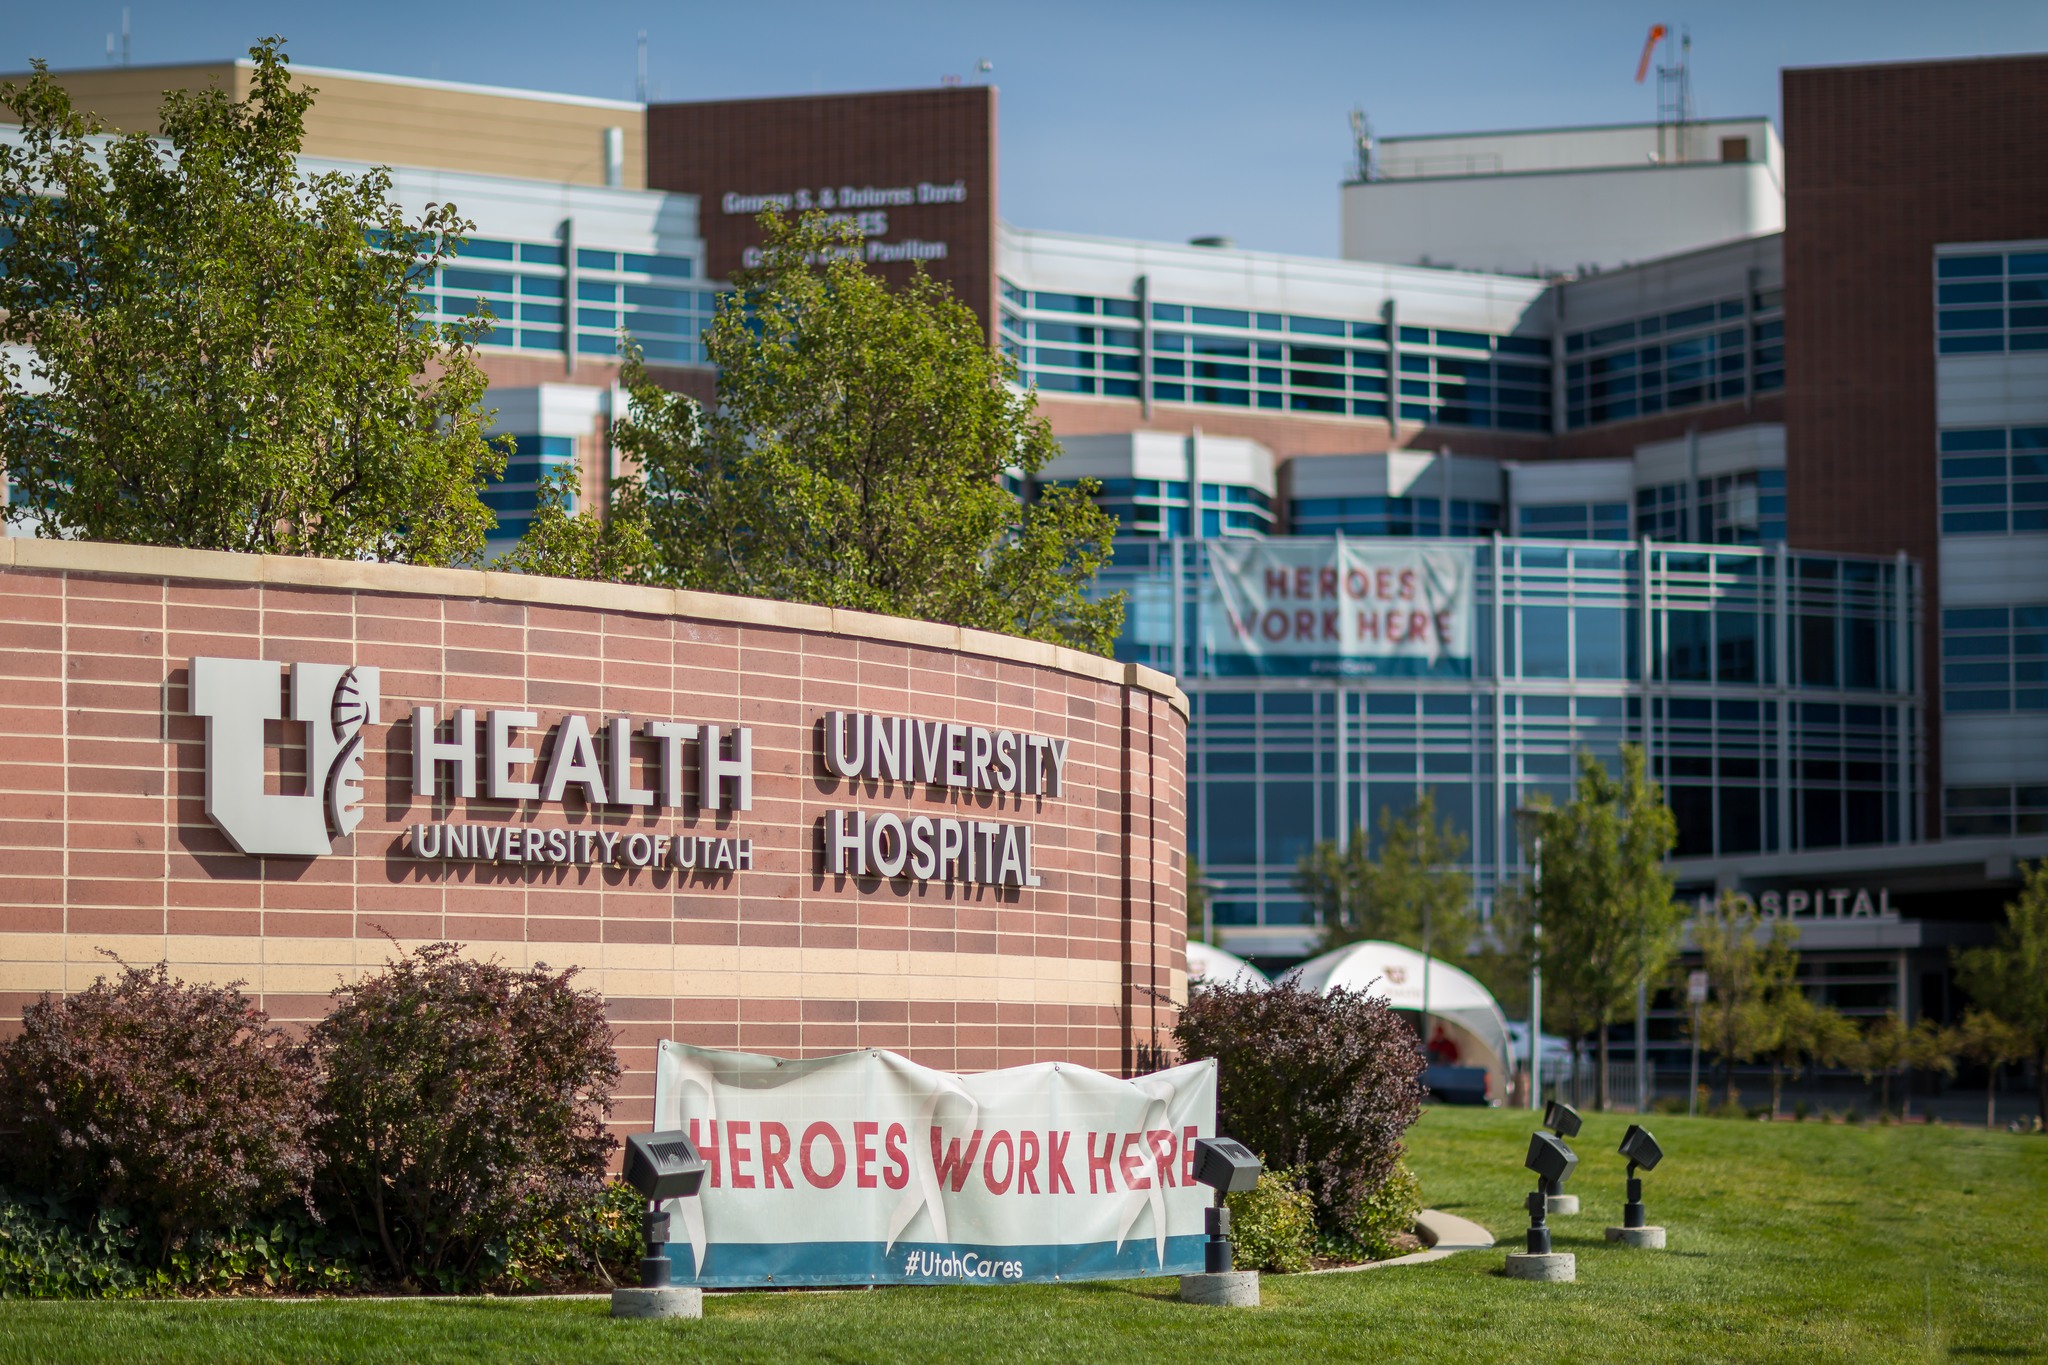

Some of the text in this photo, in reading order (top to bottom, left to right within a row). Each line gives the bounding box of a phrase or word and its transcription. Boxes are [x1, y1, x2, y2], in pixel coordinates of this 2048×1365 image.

[1265, 566, 1416, 599] HEROES
[1356, 609, 1455, 643] HERE
[412, 706, 752, 811] HEALTH
[825, 711, 1069, 797] UNIVERSITY
[412, 824, 753, 870] UNIVERSITY OF UTAH
[825, 809, 1041, 886] HOSPITAL
[689, 1118, 1198, 1196] HEROES WORK HERE
[905, 1250, 1023, 1279] #UtahCares
